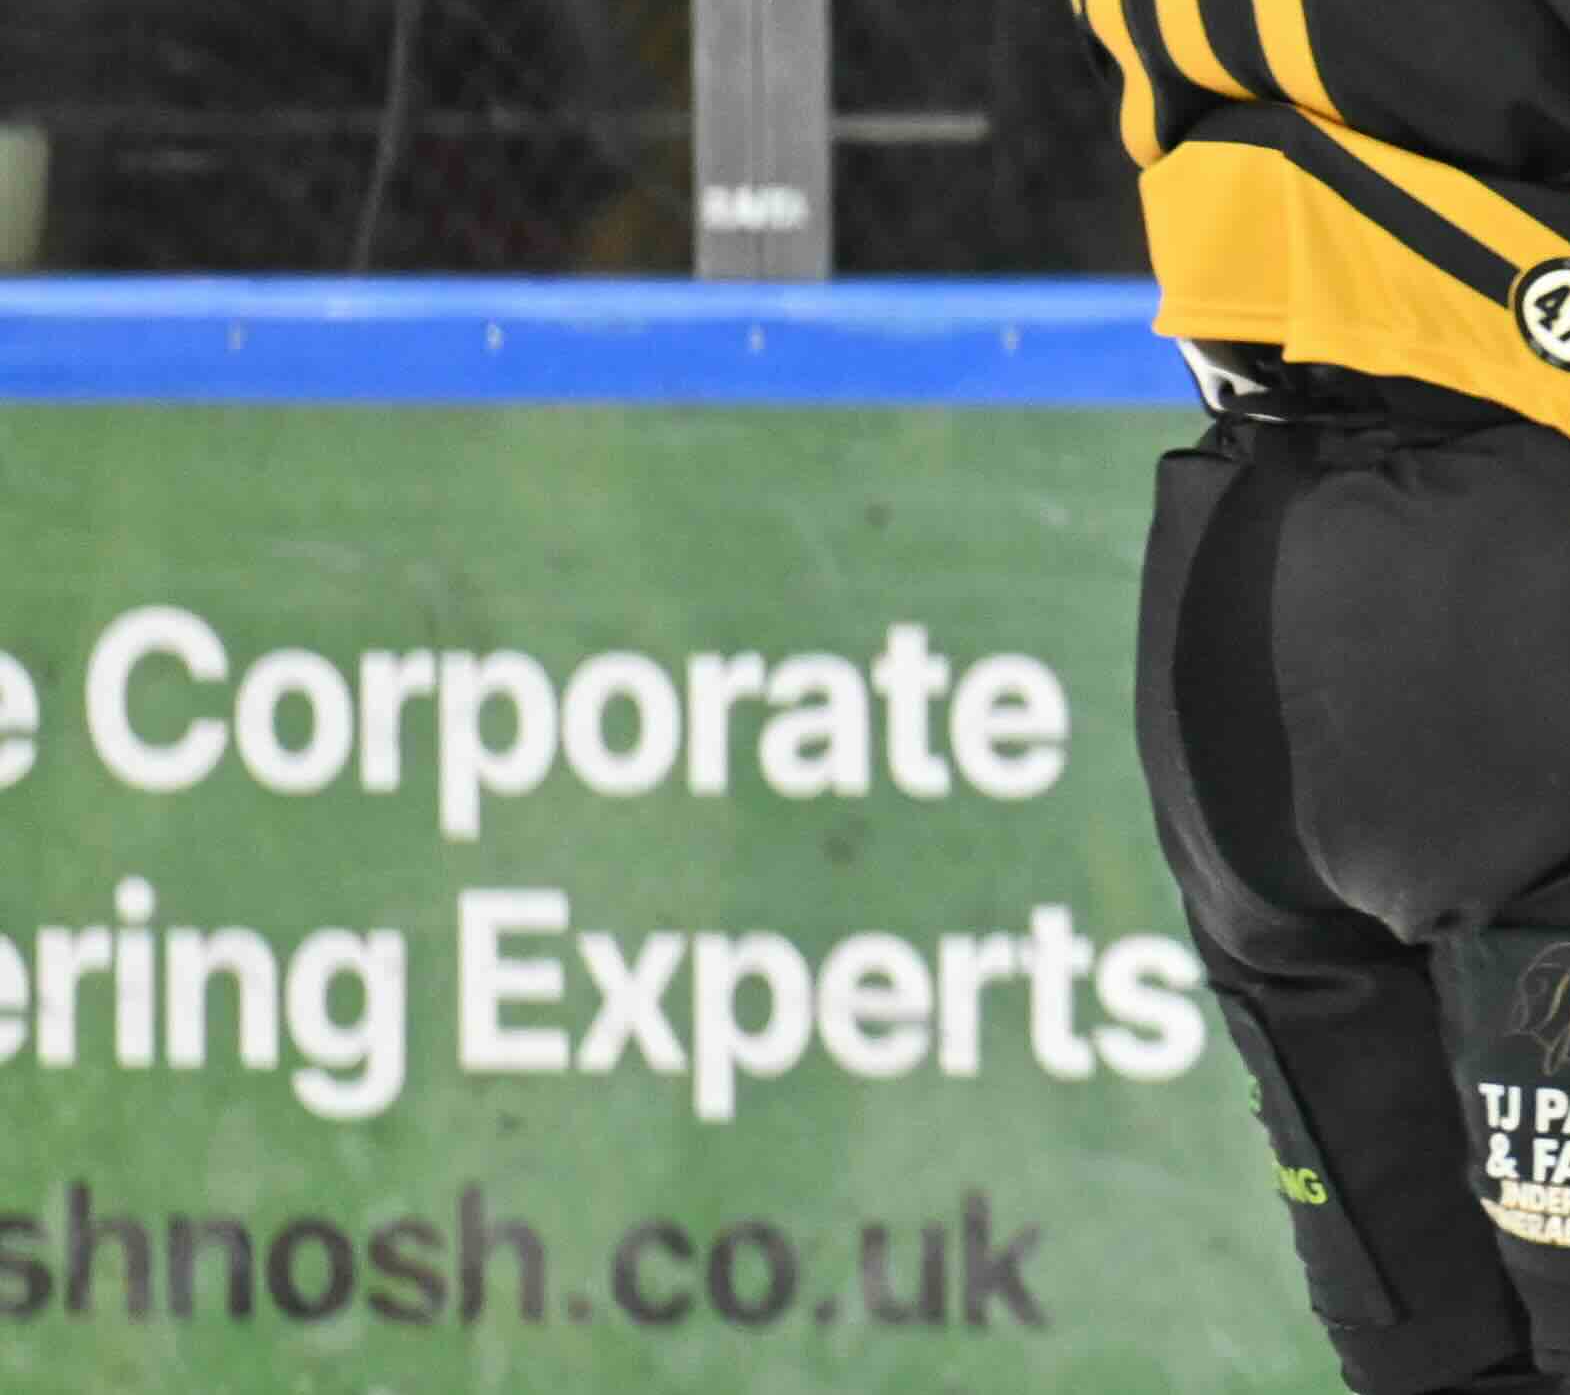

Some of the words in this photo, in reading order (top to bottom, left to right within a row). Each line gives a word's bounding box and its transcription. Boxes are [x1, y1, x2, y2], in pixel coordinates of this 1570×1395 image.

[85, 605, 1070, 842] Corporate
[0, 875, 407, 1121] ring
[457, 885, 1208, 1123] Experts
[1478, 1083, 1521, 1130] TJ
[1485, 1132, 1518, 1181] &
